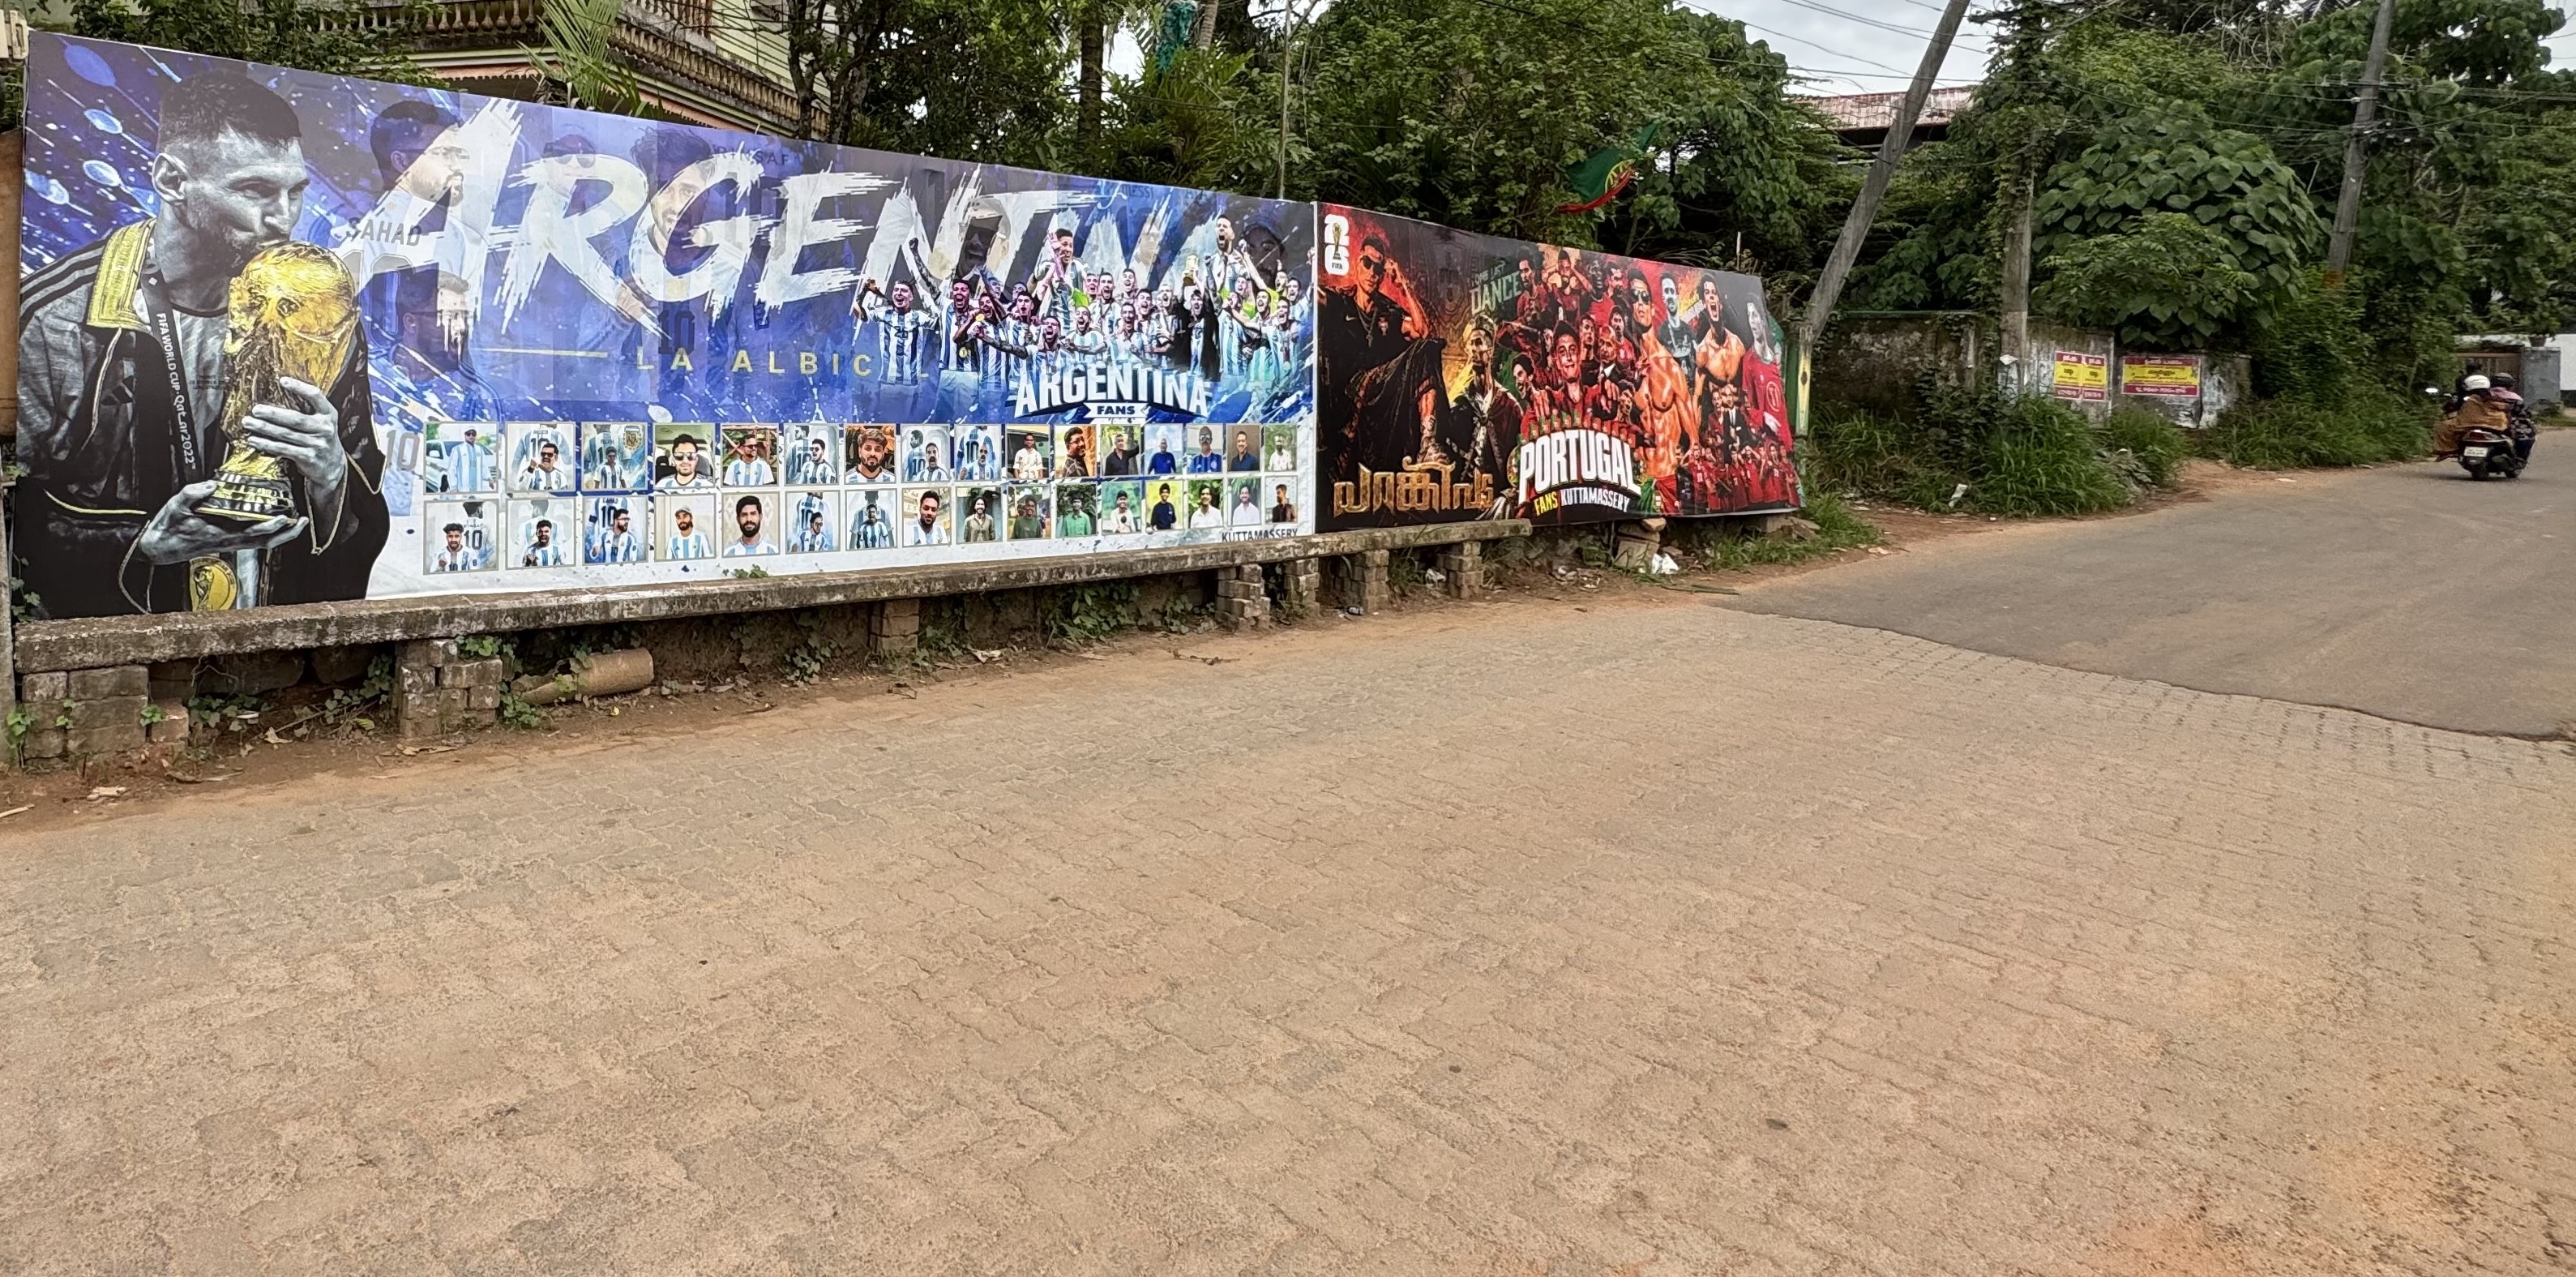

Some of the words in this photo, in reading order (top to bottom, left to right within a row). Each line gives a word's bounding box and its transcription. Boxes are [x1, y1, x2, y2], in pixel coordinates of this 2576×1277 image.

[346, 216, 422, 246] SAHAD
[1469, 270, 1523, 317] DANCE
[156, 313, 169, 336] FIFA
[161, 335, 177, 371] WORLD
[636, 345, 694, 371] LA
[731, 349, 929, 379] ALBIC
[169, 371, 181, 392] CUP
[1014, 362, 1208, 418] ARGENTINA
[1097, 405, 1136, 415] FANS
[386, 429, 421, 472] 10
[1518, 429, 1642, 506] PORTUGAL
[1534, 491, 1560, 517] FANS
[1560, 486, 1631, 513] KUTTAMASSERY
[464, 529, 483, 551] 10
[1222, 528, 1299, 543] KUTTAMASSERY
